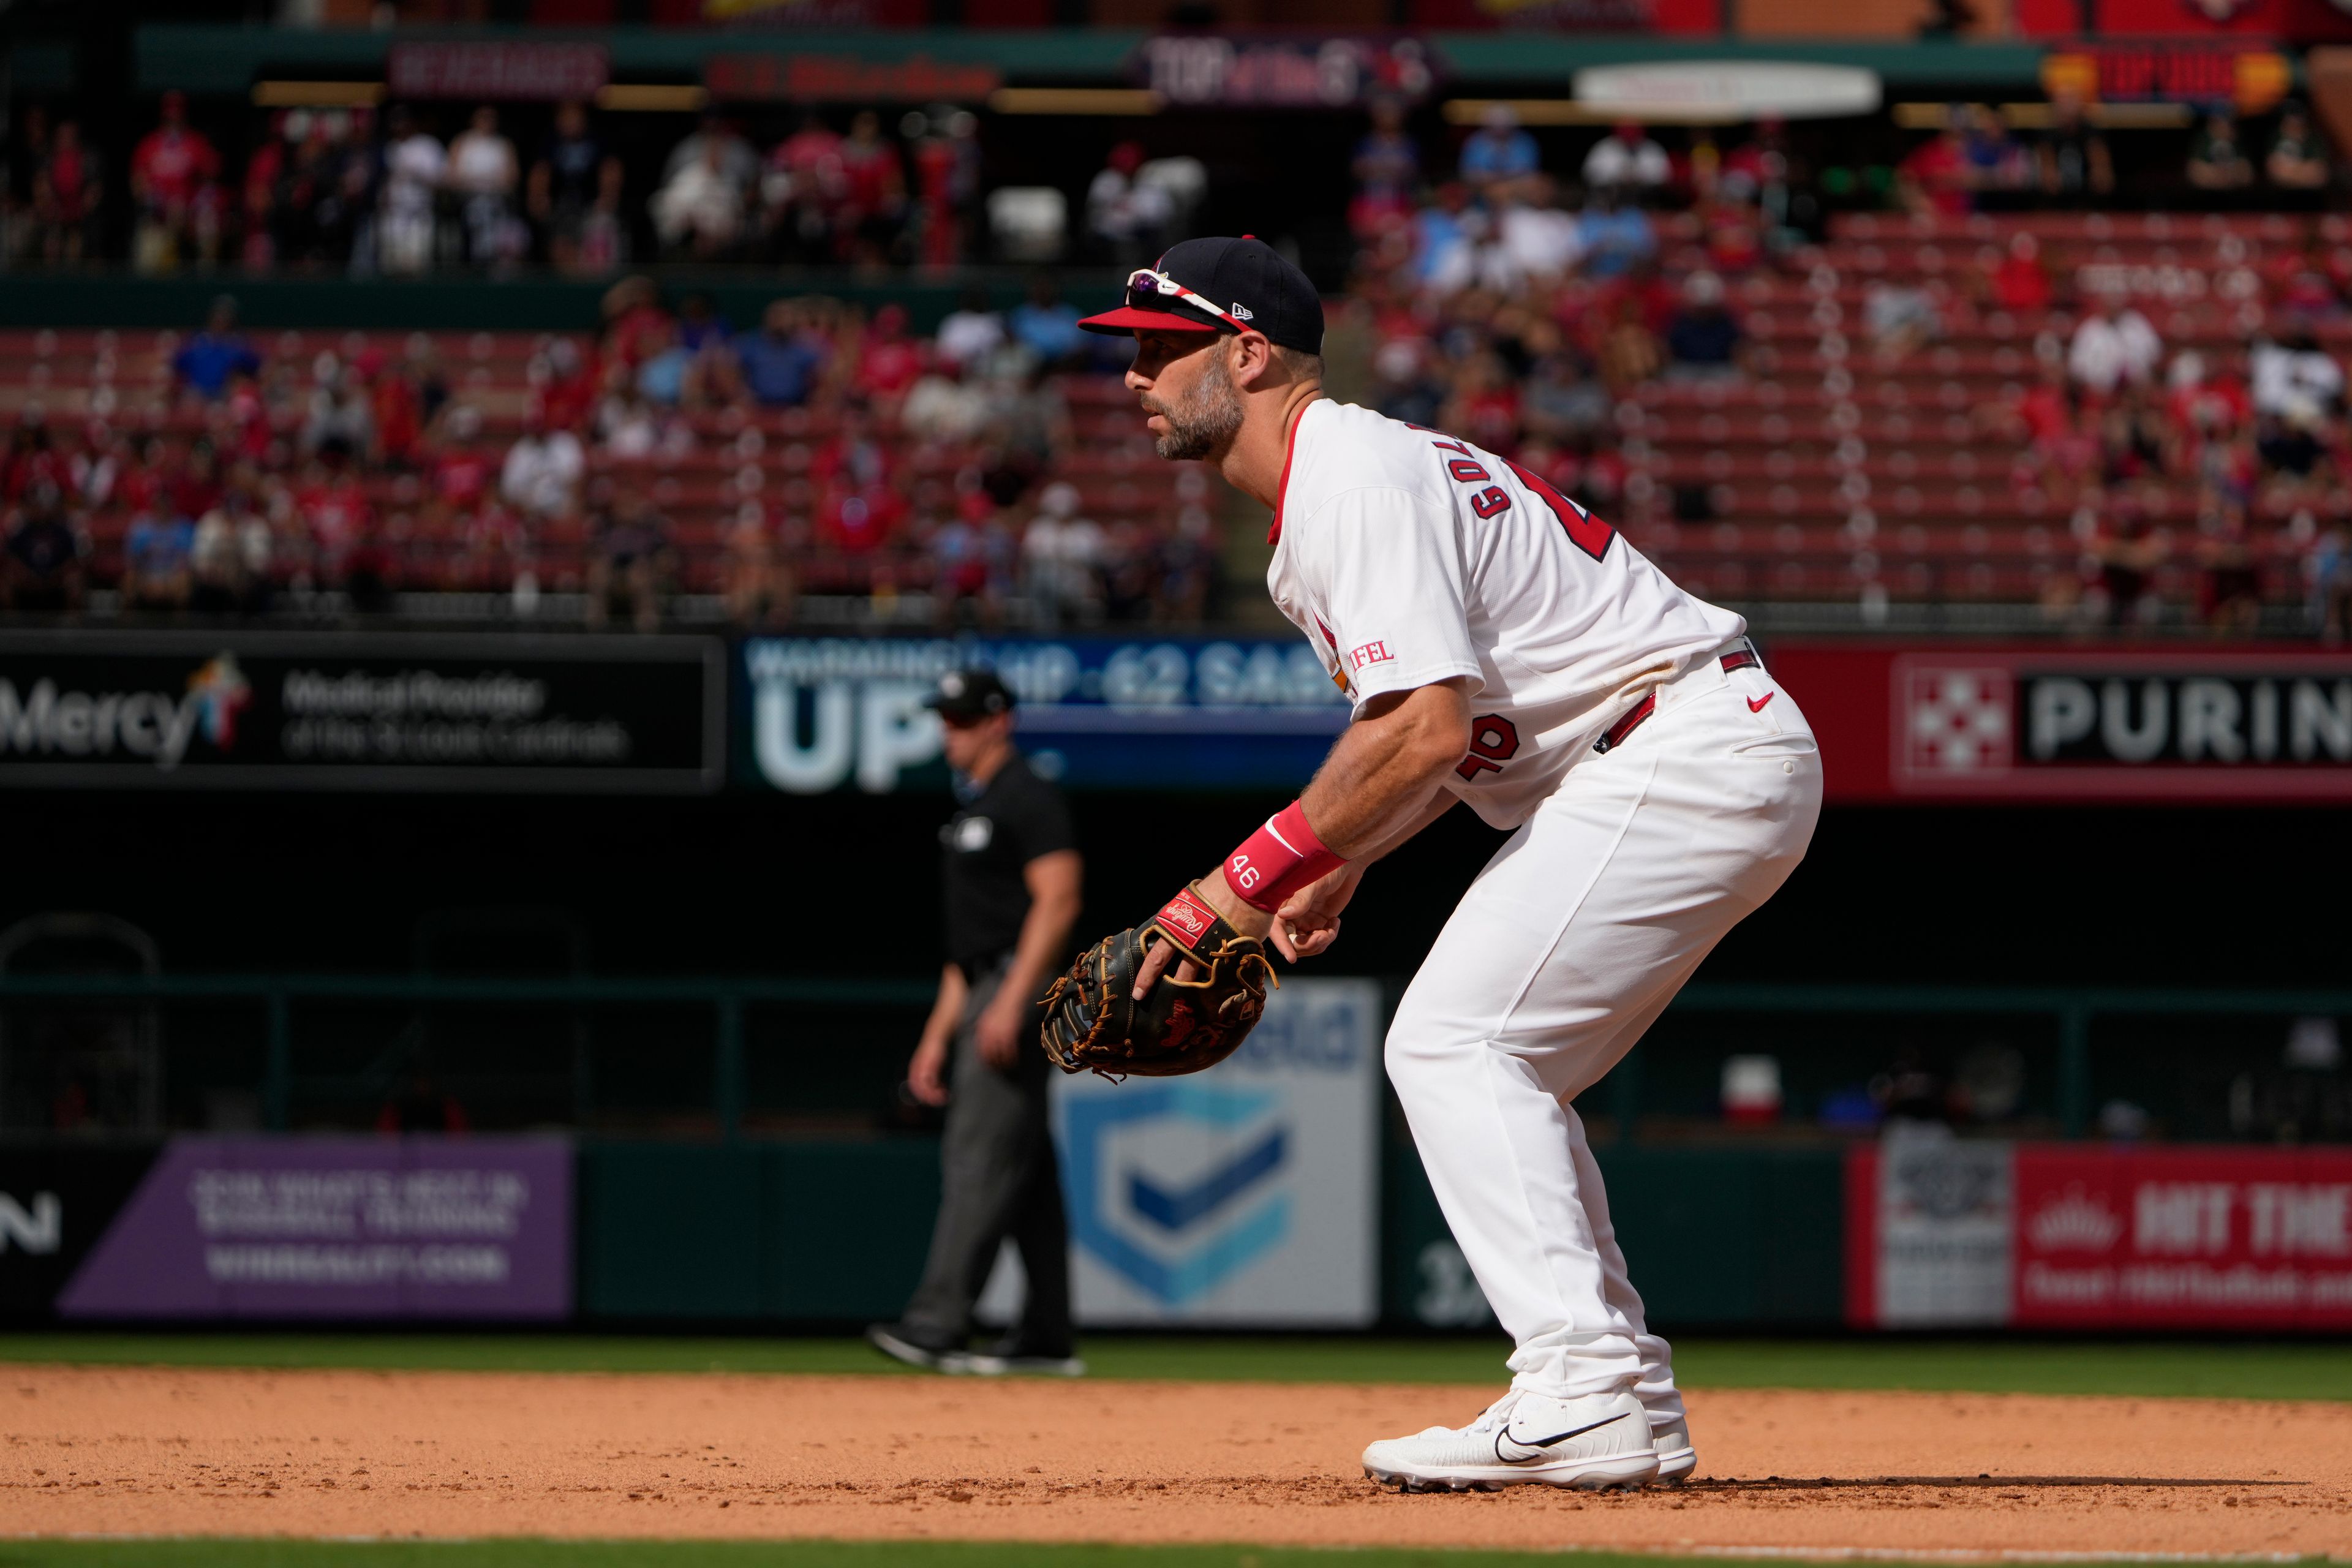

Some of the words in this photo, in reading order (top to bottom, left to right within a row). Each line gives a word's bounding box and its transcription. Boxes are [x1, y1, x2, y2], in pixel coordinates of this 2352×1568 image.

[1404, 421, 1512, 520] GOL
[0, 677, 196, 771] Mercy
[755, 685, 947, 795] UP
[2030, 677, 2352, 761] PURIN
[1232, 854, 1260, 889] 46
[1166, 903, 1204, 932] Rawlings
